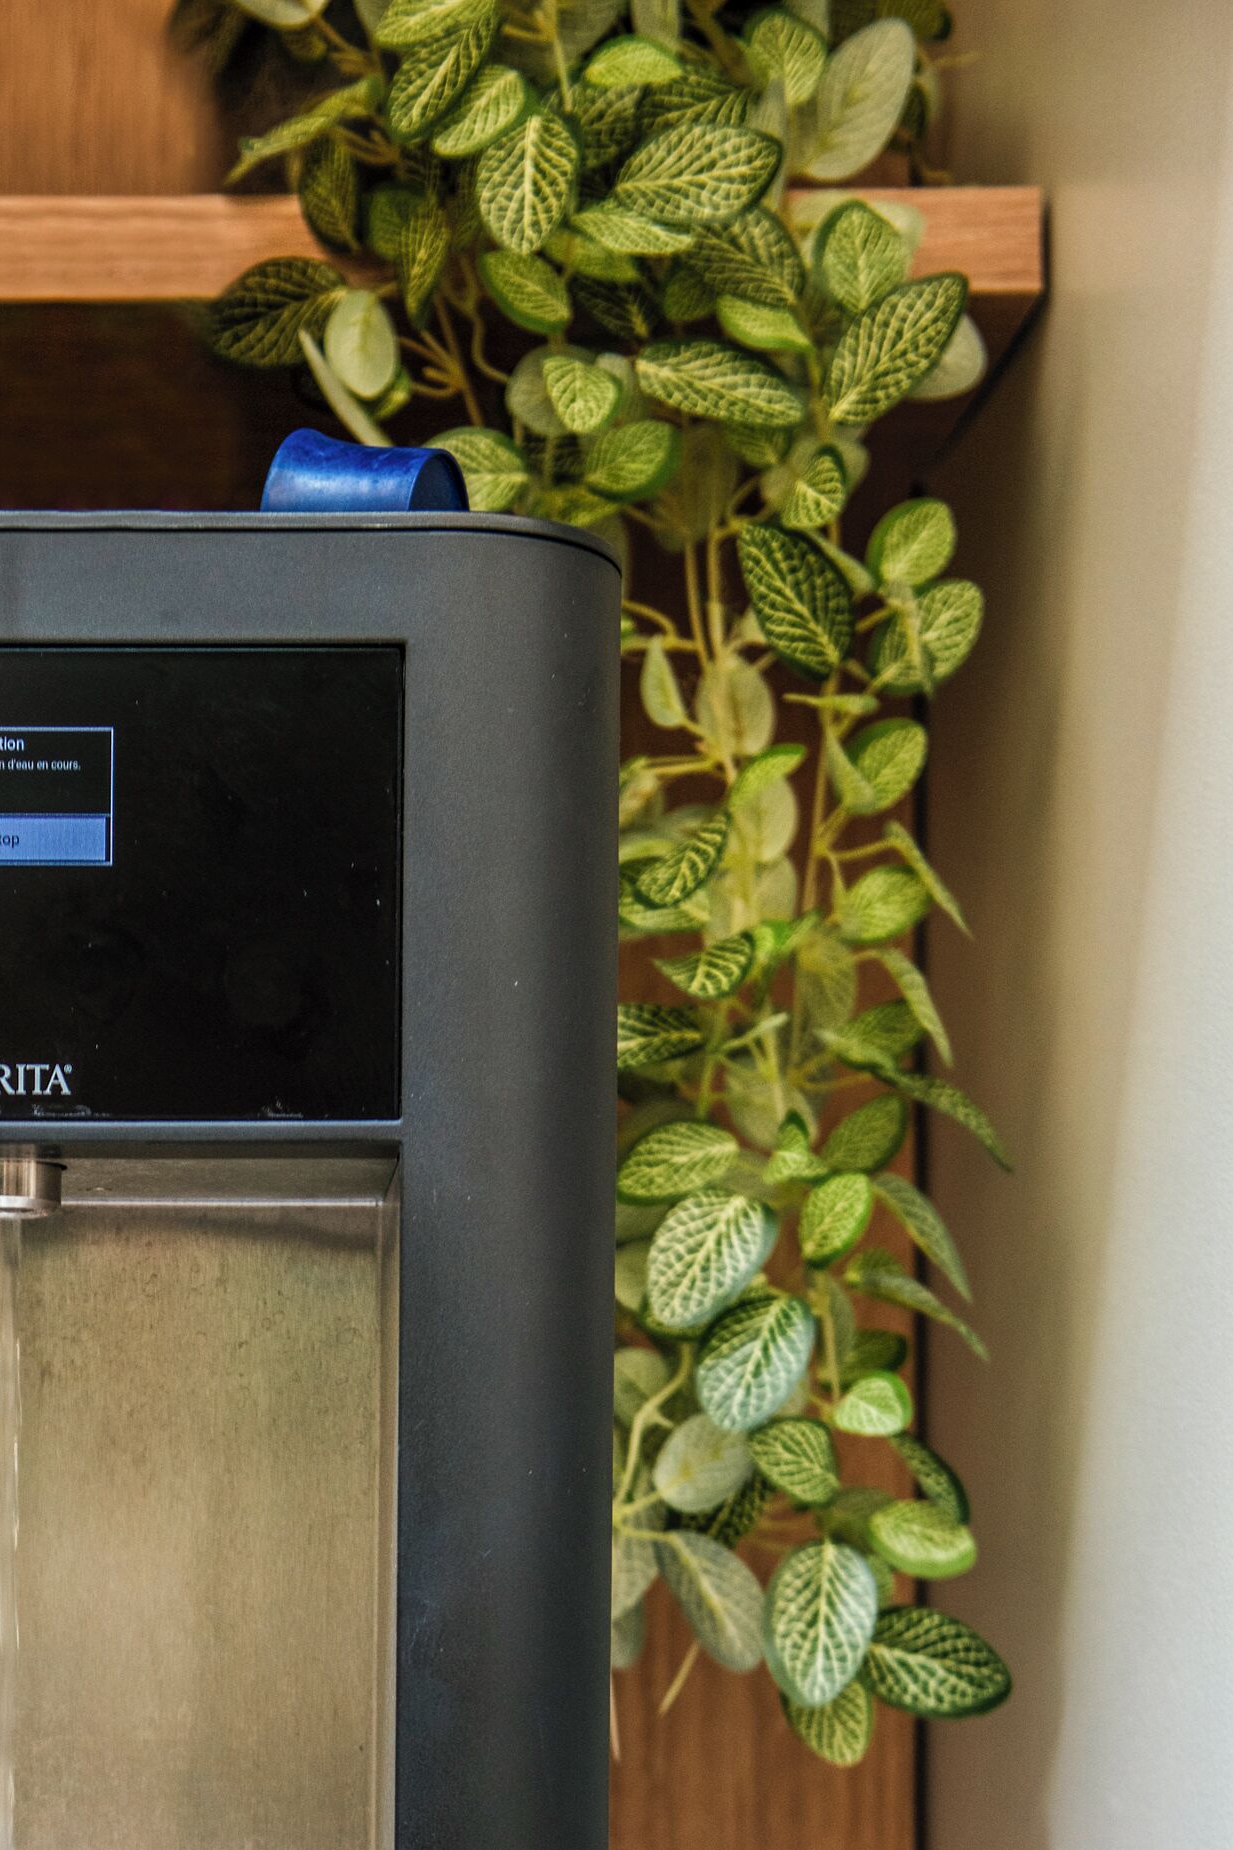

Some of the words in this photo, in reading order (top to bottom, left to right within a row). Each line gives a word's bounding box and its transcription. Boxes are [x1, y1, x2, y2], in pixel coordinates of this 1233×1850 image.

[7, 758, 34, 771] d'eau
[36, 760, 49, 771] en
[51, 760, 81, 771] cours.
